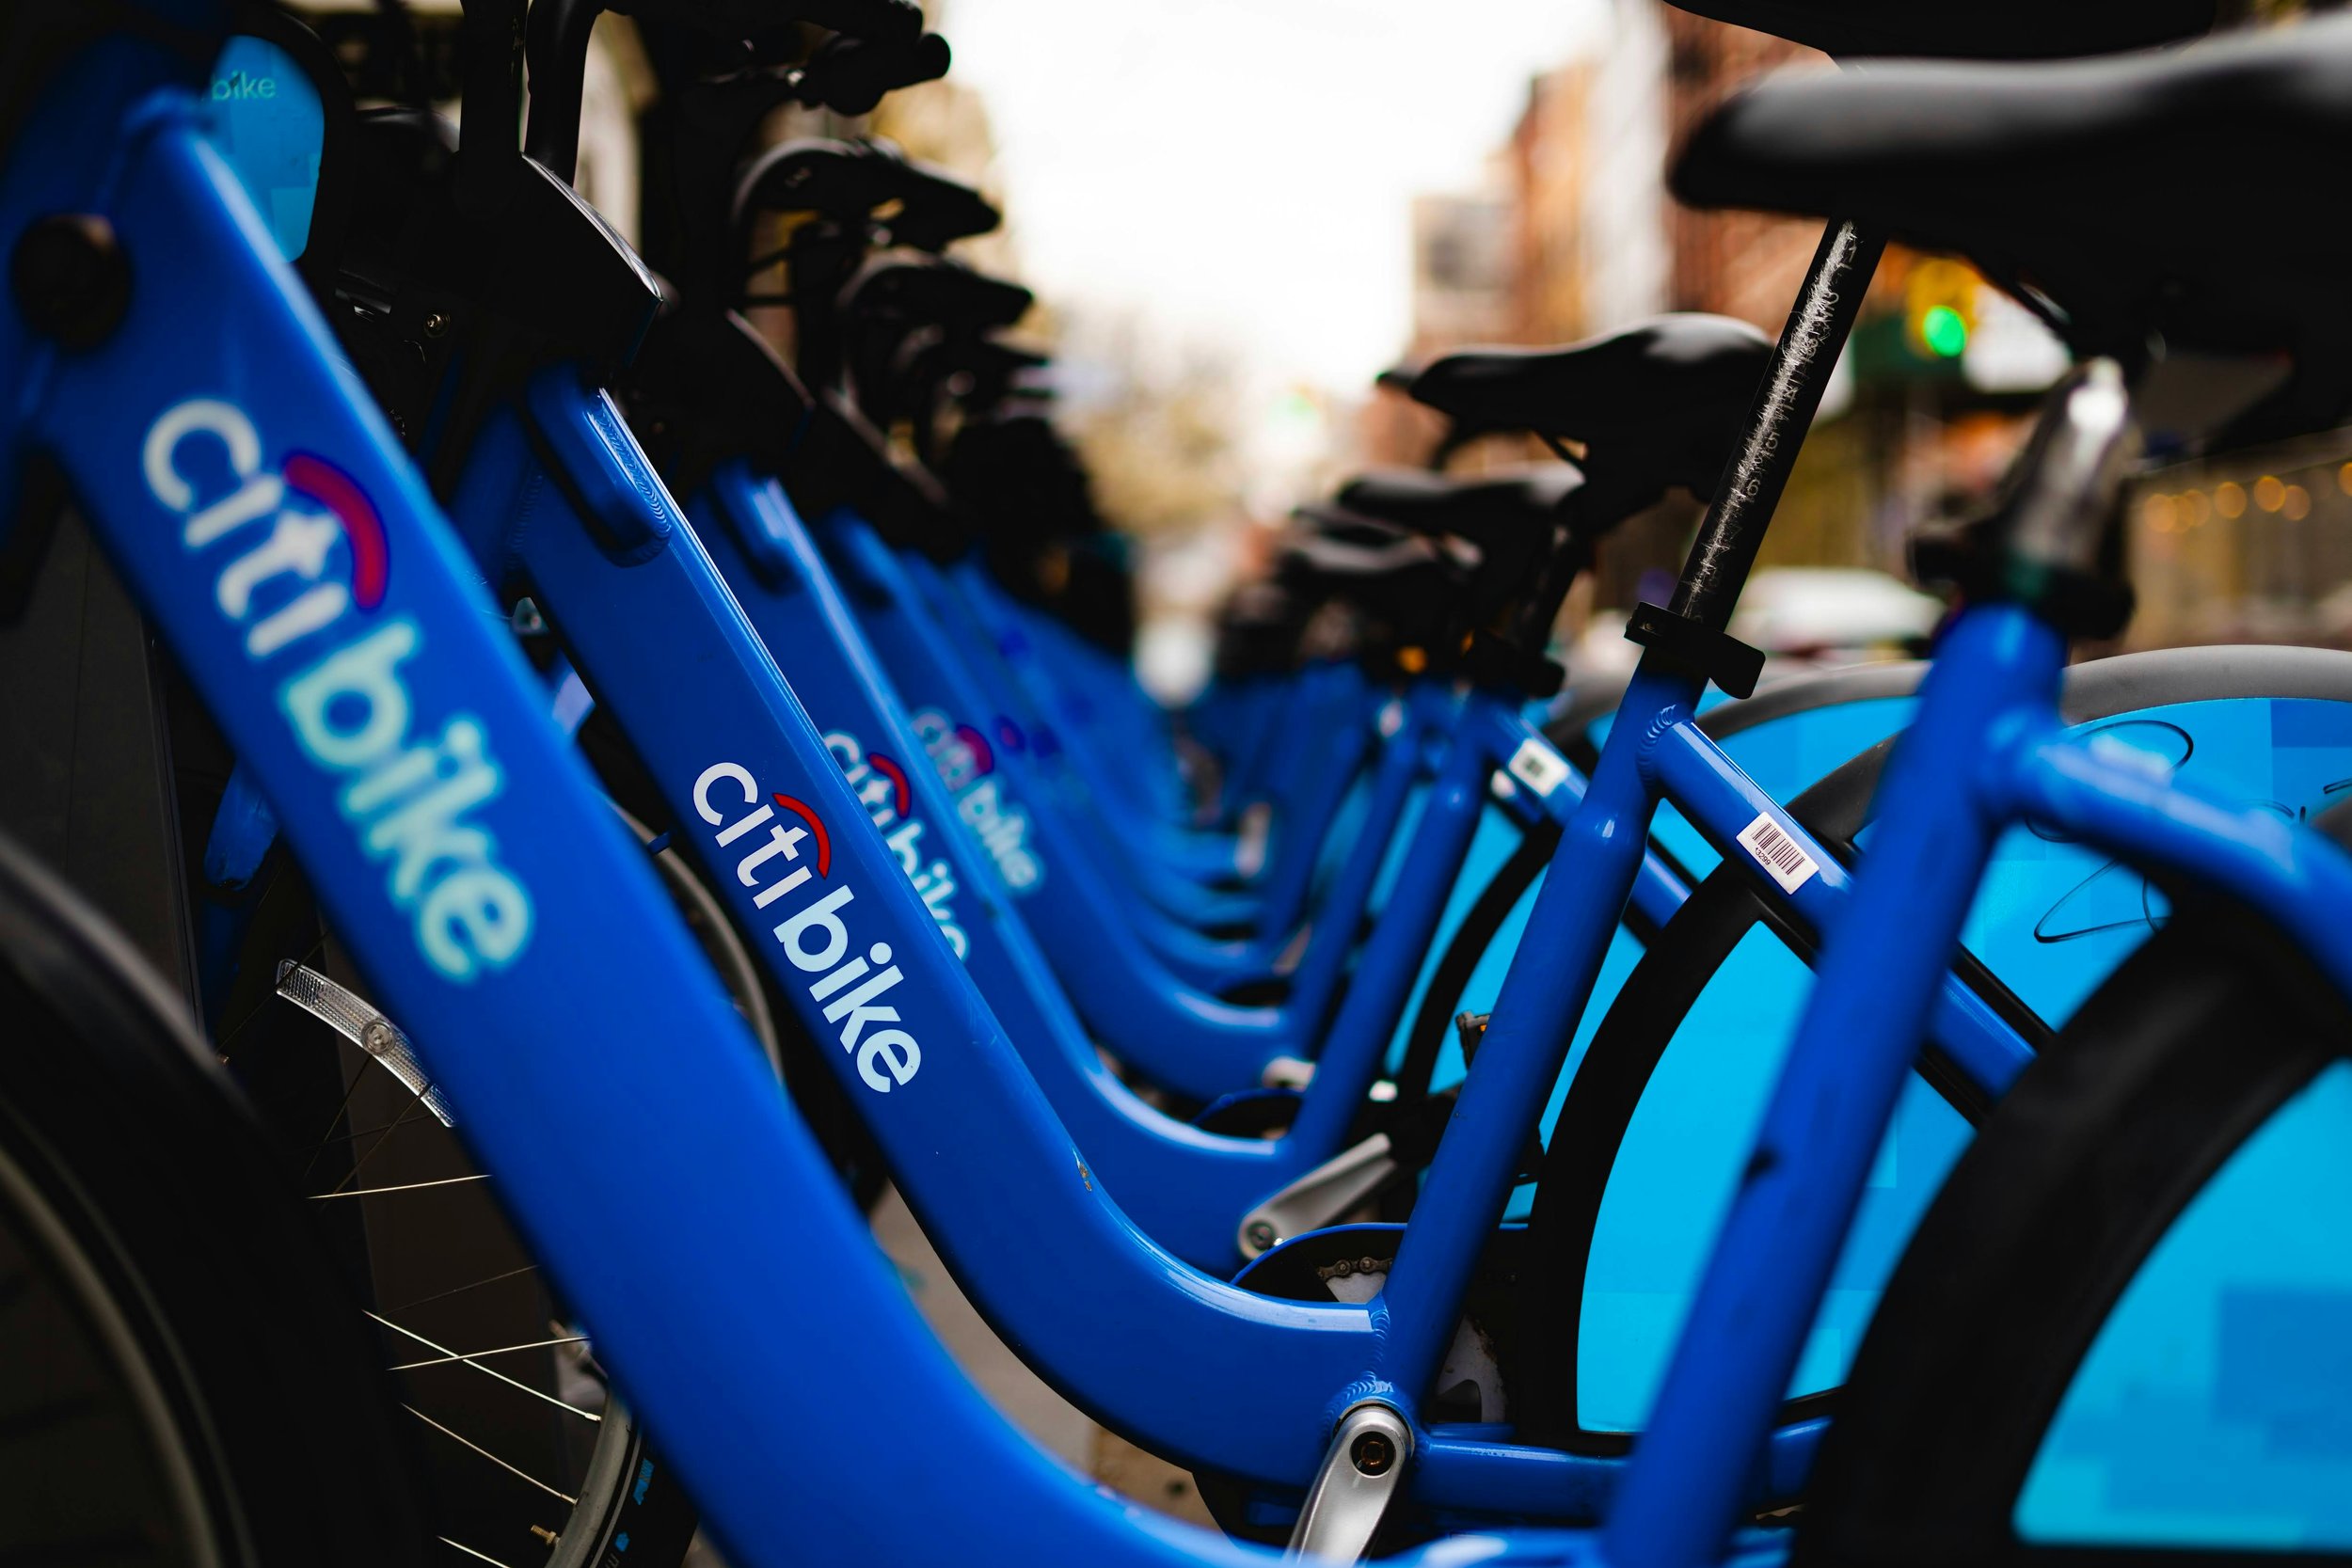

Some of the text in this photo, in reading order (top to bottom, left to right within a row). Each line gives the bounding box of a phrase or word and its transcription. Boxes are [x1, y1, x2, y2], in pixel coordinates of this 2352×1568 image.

[211, 71, 277, 101] bike
[1765, 432, 1781, 450] 5
[1746, 478, 1762, 497] 6
[143, 398, 531, 980] citi bike
[692, 761, 922, 1093] citi bike
